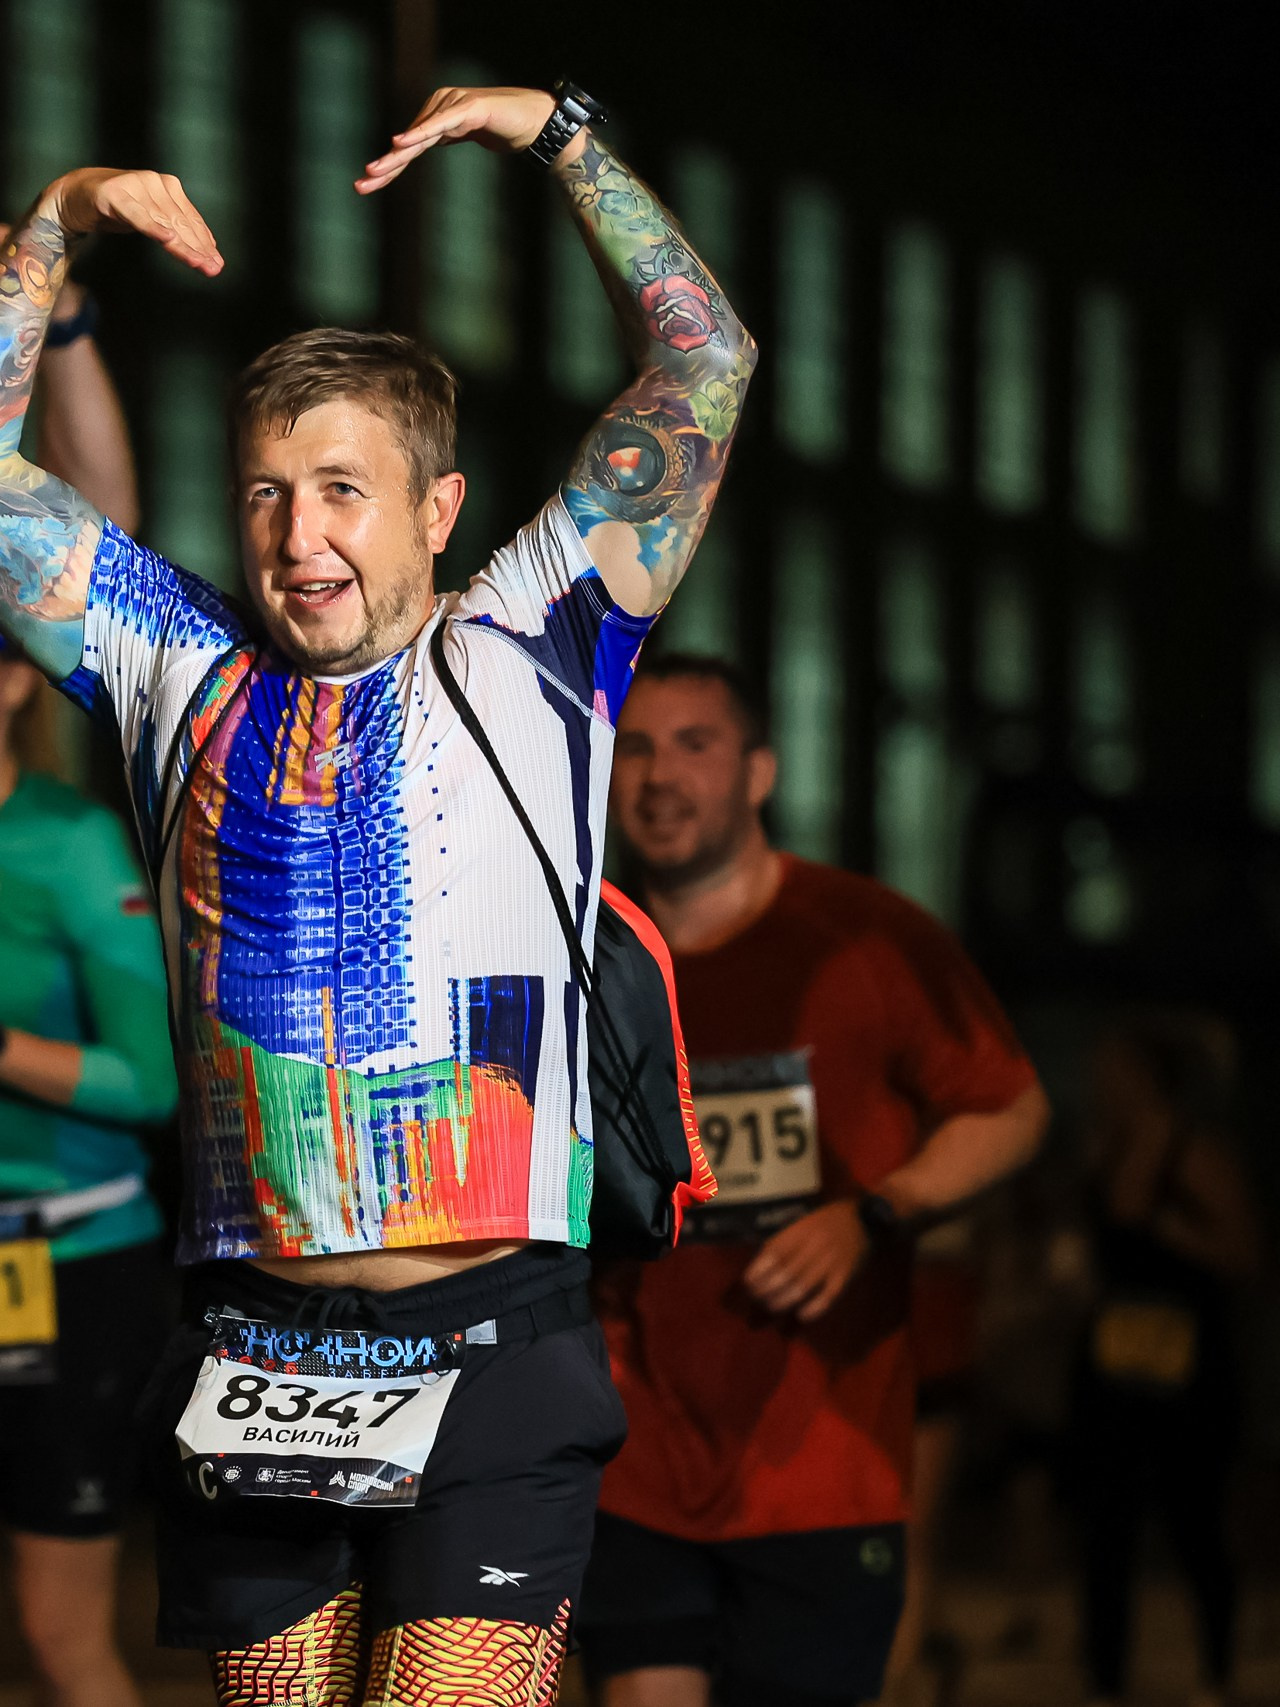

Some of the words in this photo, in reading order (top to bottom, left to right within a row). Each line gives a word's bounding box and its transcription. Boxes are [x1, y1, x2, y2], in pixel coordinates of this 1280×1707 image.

[701, 1105, 807, 1167] 915
[216, 1373, 421, 1430] 8347
[241, 1425, 361, 1449] ВАСИЛИЙ
[346, 1480, 371, 1494] СПОРТ
